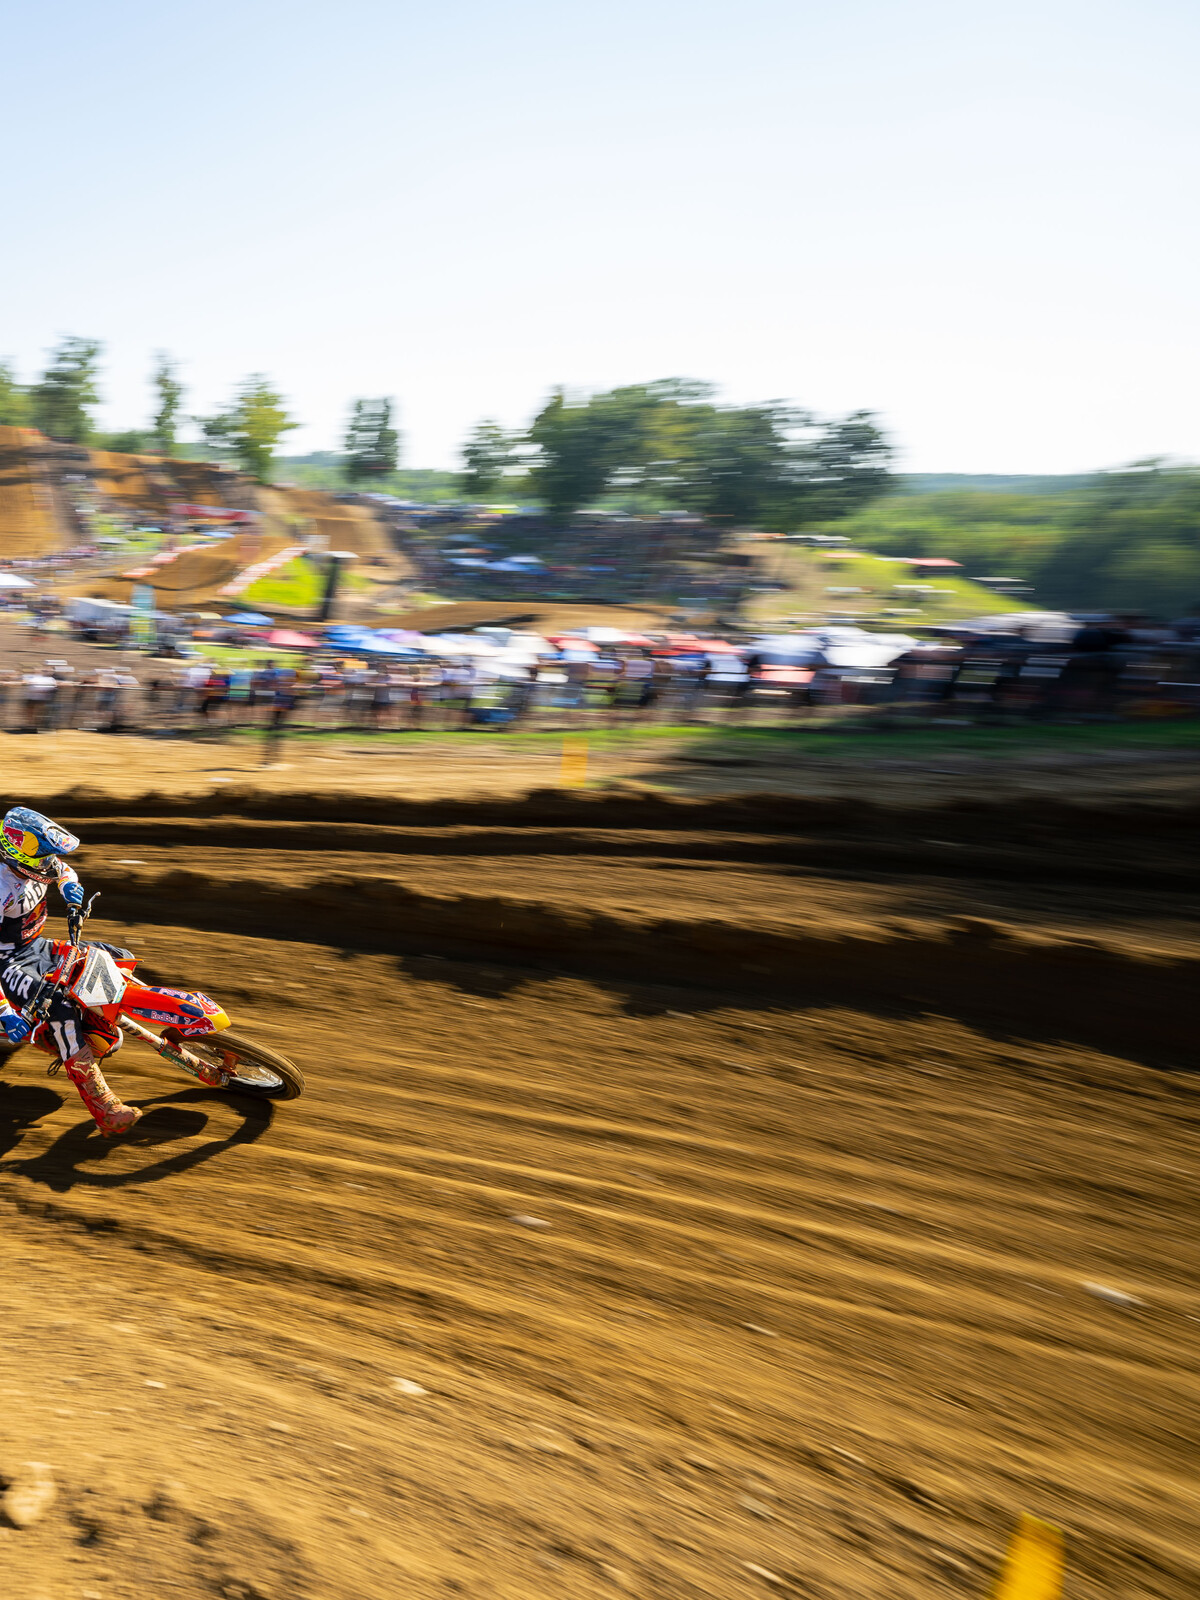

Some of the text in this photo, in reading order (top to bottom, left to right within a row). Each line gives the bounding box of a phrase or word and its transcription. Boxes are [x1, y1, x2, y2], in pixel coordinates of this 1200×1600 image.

[17, 883, 43, 914] THO
[2, 964, 34, 1000] HOR
[86, 954, 117, 1004] 7
[151, 1010, 165, 1021] Red
[163, 1012, 180, 1025] Bull
